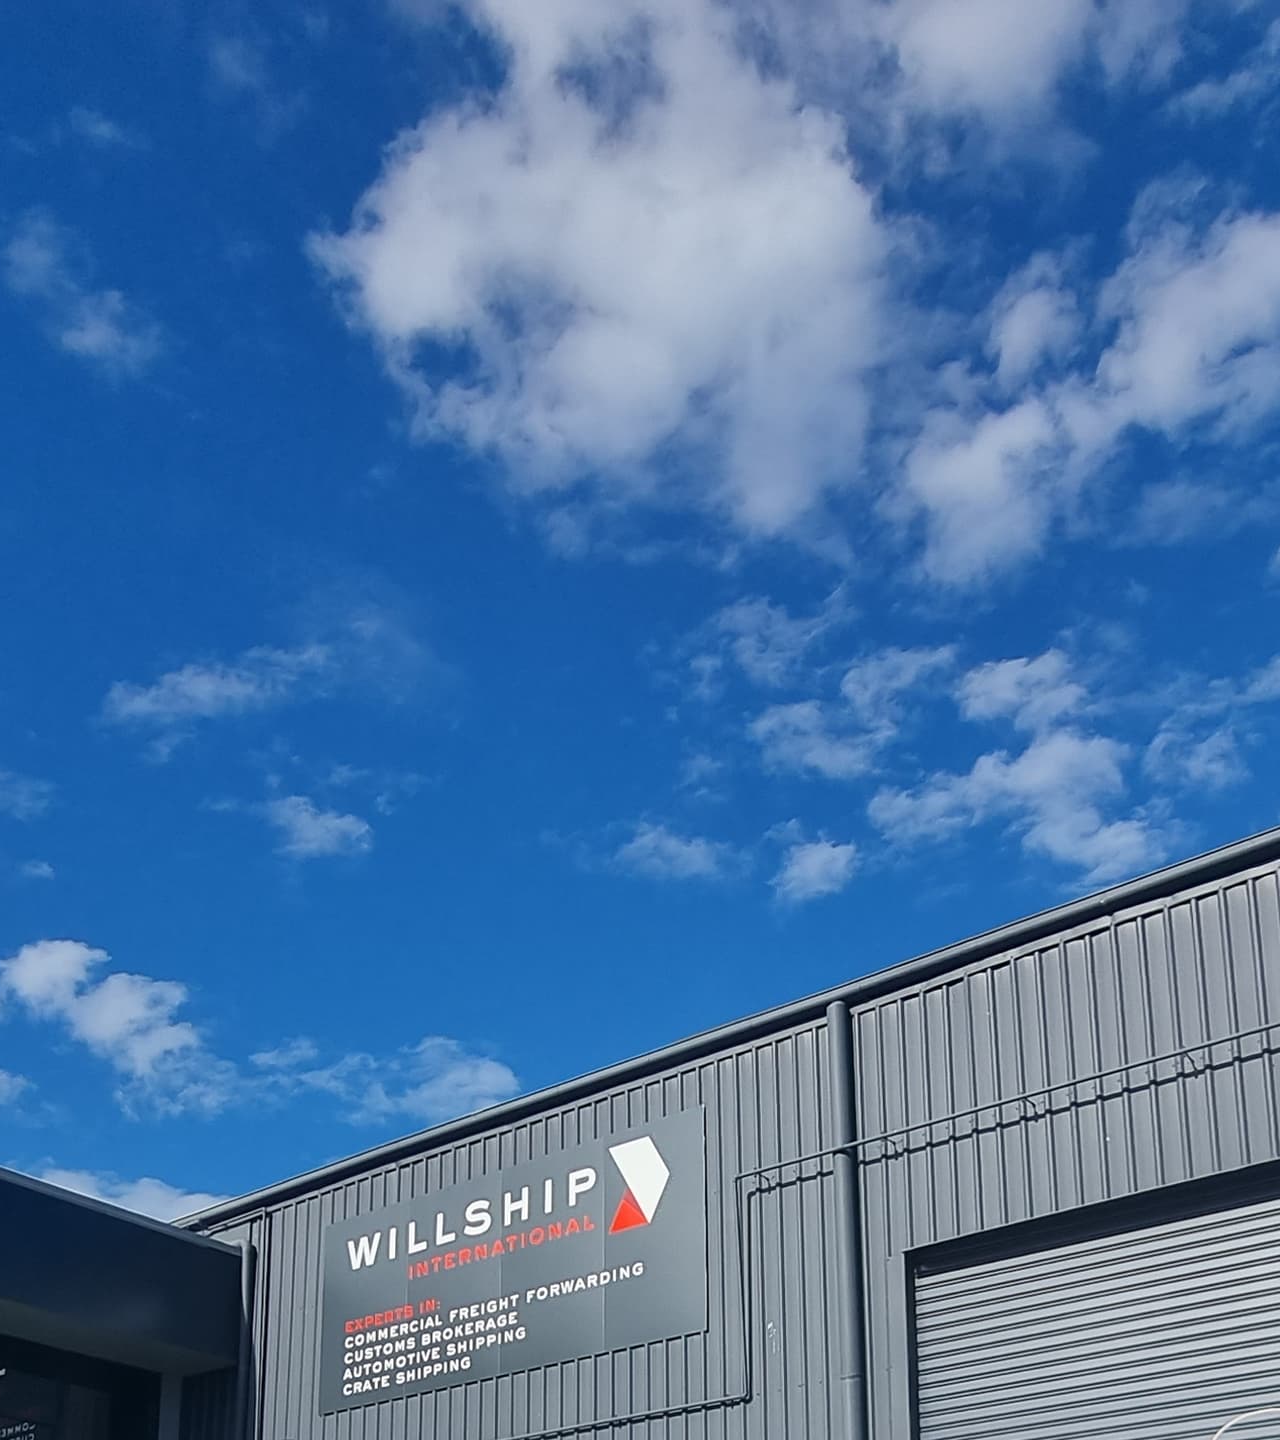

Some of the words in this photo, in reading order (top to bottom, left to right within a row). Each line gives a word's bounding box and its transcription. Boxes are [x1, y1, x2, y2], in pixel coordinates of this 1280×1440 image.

[347, 1167, 597, 1271] WILLSHIP
[408, 1215, 595, 1280] INTERNATIONAL
[344, 1314, 443, 1349] COMMERCIAL
[449, 1294, 519, 1323] FREIGHT
[526, 1262, 643, 1303] FORWARDING
[344, 1305, 414, 1333] EXPERTS
[420, 1299, 440, 1314] IN:
[343, 1347, 440, 1380] AUTOMOTIVE
[446, 1327, 526, 1356] SHIPPING
[344, 1337, 416, 1365] CUSTOMS
[421, 1312, 518, 1346] BROKERAGE
[343, 1376, 390, 1396] CRATE
[396, 1357, 471, 1384] SHIPPING
